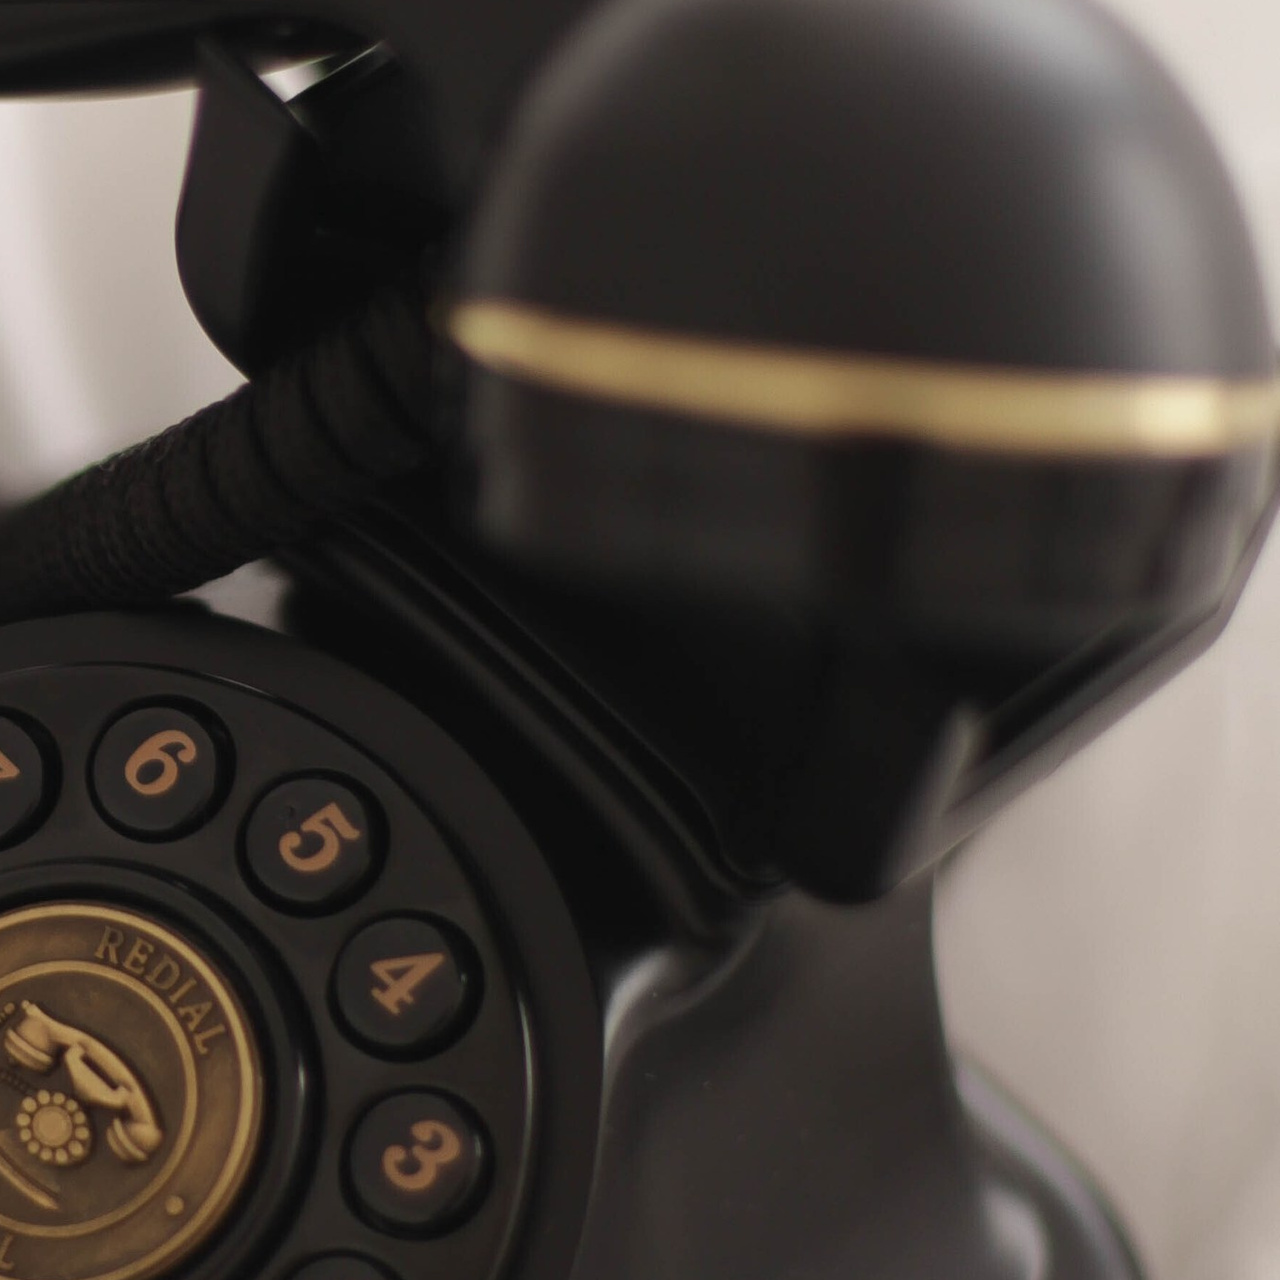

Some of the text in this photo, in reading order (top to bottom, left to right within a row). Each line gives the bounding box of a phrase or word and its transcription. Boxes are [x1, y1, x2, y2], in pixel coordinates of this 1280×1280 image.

[125, 729, 197, 796] 6
[278, 804, 361, 873] 5
[93, 925, 227, 1055] REDIAL
[371, 952, 445, 1015] 4
[381, 1119, 461, 1192] 3
